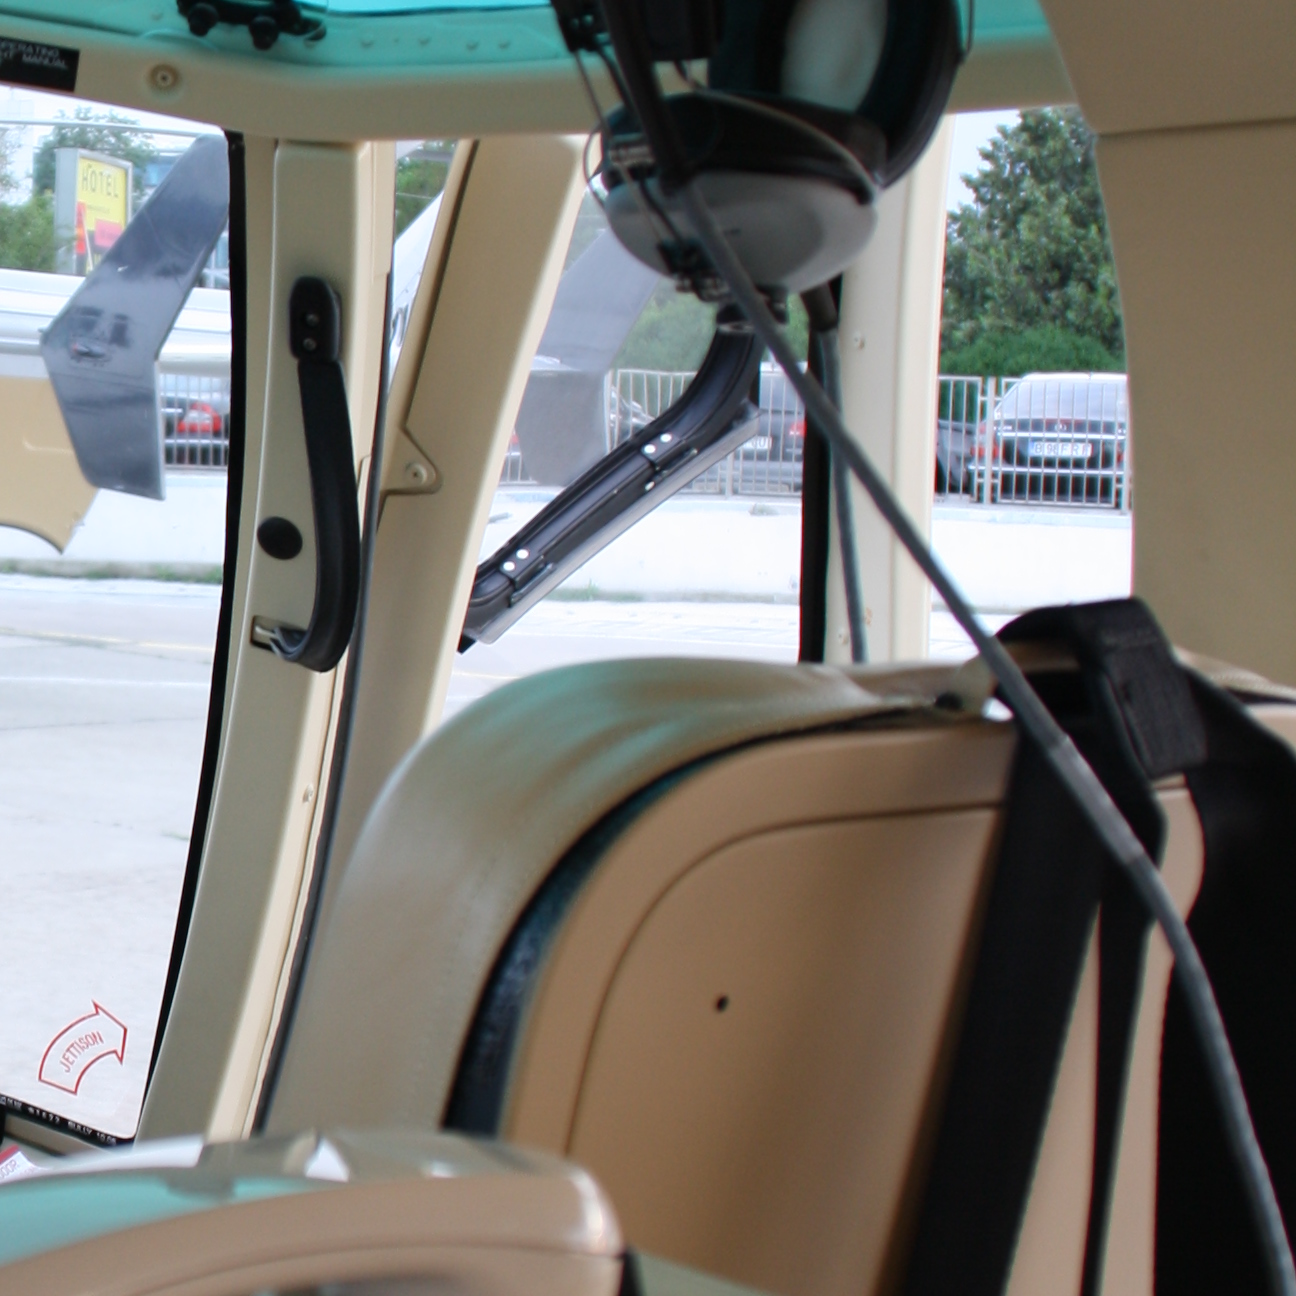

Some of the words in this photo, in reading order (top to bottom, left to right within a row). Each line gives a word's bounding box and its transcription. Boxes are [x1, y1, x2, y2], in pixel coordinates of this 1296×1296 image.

[21, 53, 68, 70] MANUAL
[81, 164, 120, 199] HOTEL
[59, 1030, 105, 1073] JETTISON
